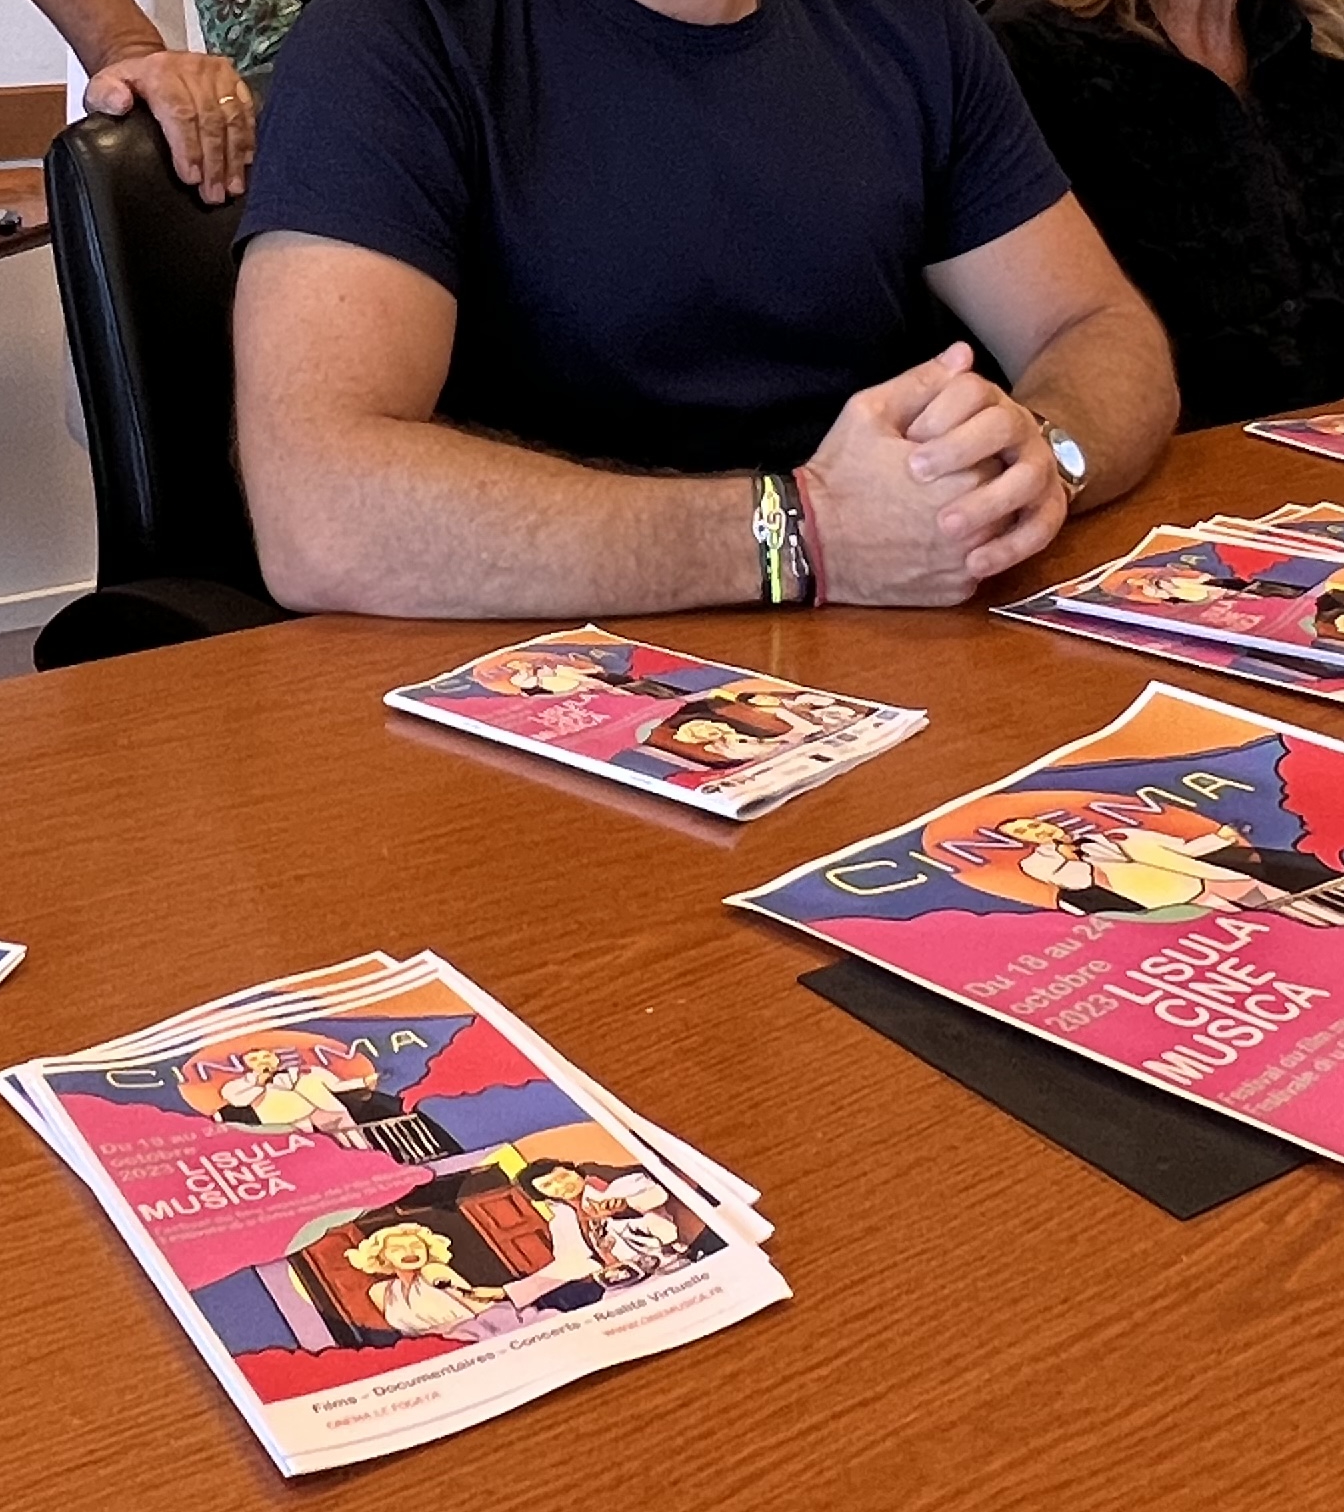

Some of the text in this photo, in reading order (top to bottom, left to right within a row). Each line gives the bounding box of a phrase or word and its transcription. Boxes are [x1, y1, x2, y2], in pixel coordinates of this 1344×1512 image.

[965, 914, 1115, 999] Du 18 au 24
[1103, 916, 1270, 1006] LISULA
[1010, 959, 1112, 1015] octobre
[1044, 993, 1120, 1034] 2023
[1154, 956, 1276, 1028] CINE
[1142, 980, 1331, 1086] MUSICA
[176, 1133, 316, 1178] LISULA
[186, 1161, 283, 1194] CINE
[137, 1175, 296, 1223] MUSICA
